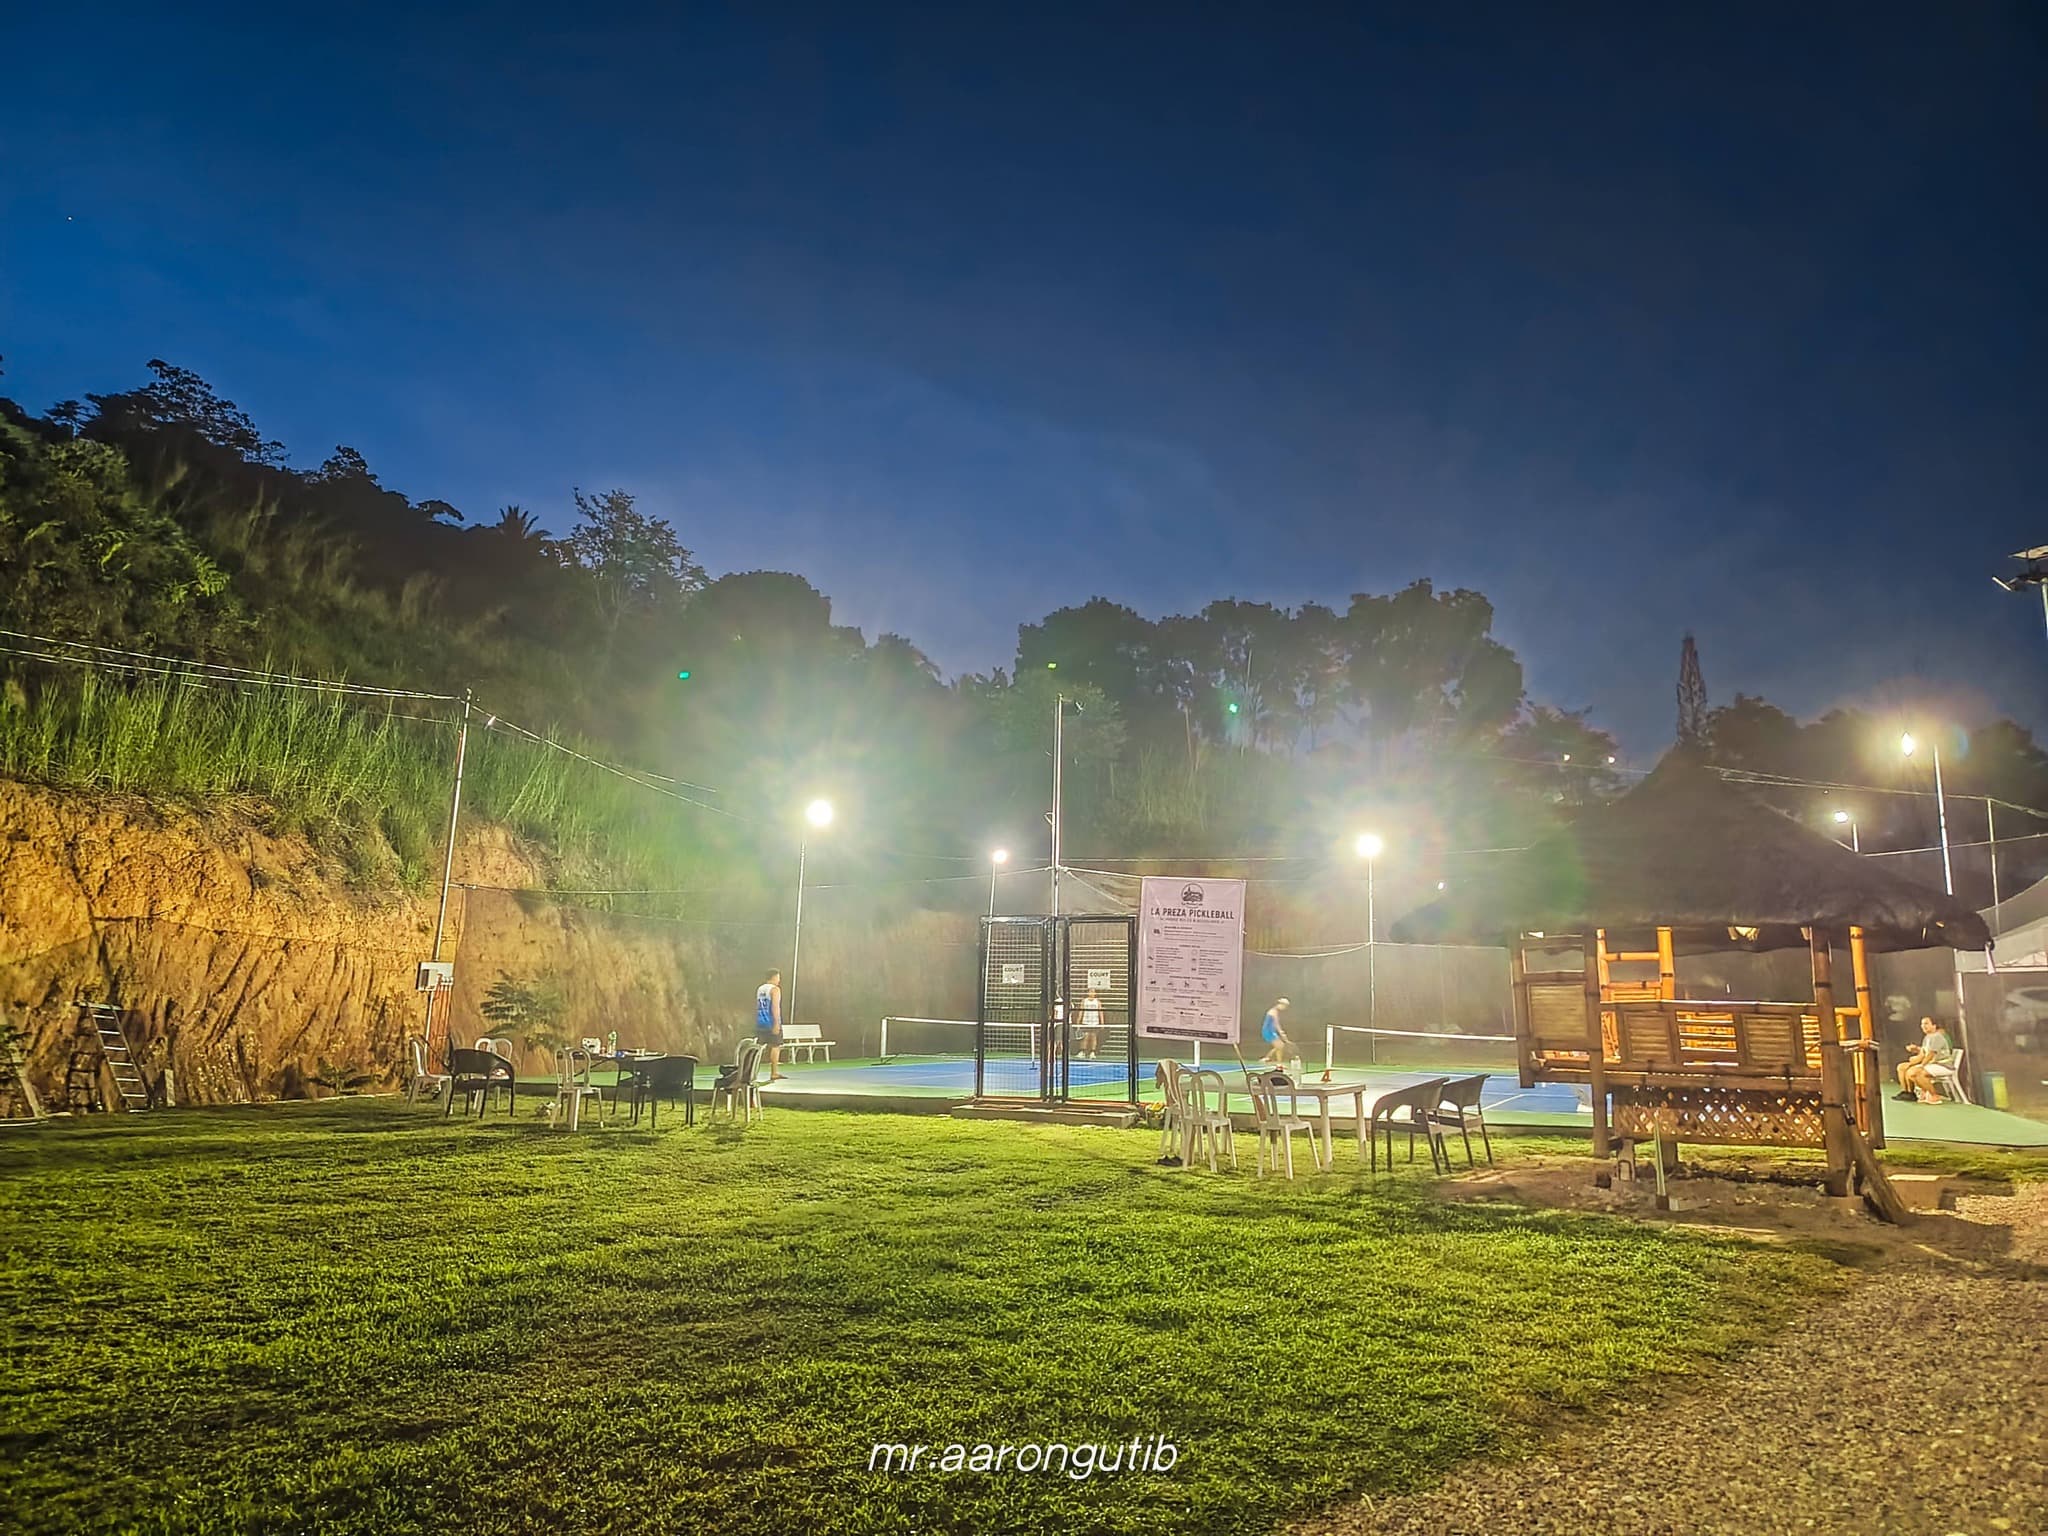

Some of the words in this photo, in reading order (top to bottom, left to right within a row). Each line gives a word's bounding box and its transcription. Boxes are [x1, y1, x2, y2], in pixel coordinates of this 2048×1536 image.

[1151, 907, 1160, 916] LA
[1163, 908, 1186, 917] PREZA
[1189, 910, 1234, 919] PICKLEBALL
